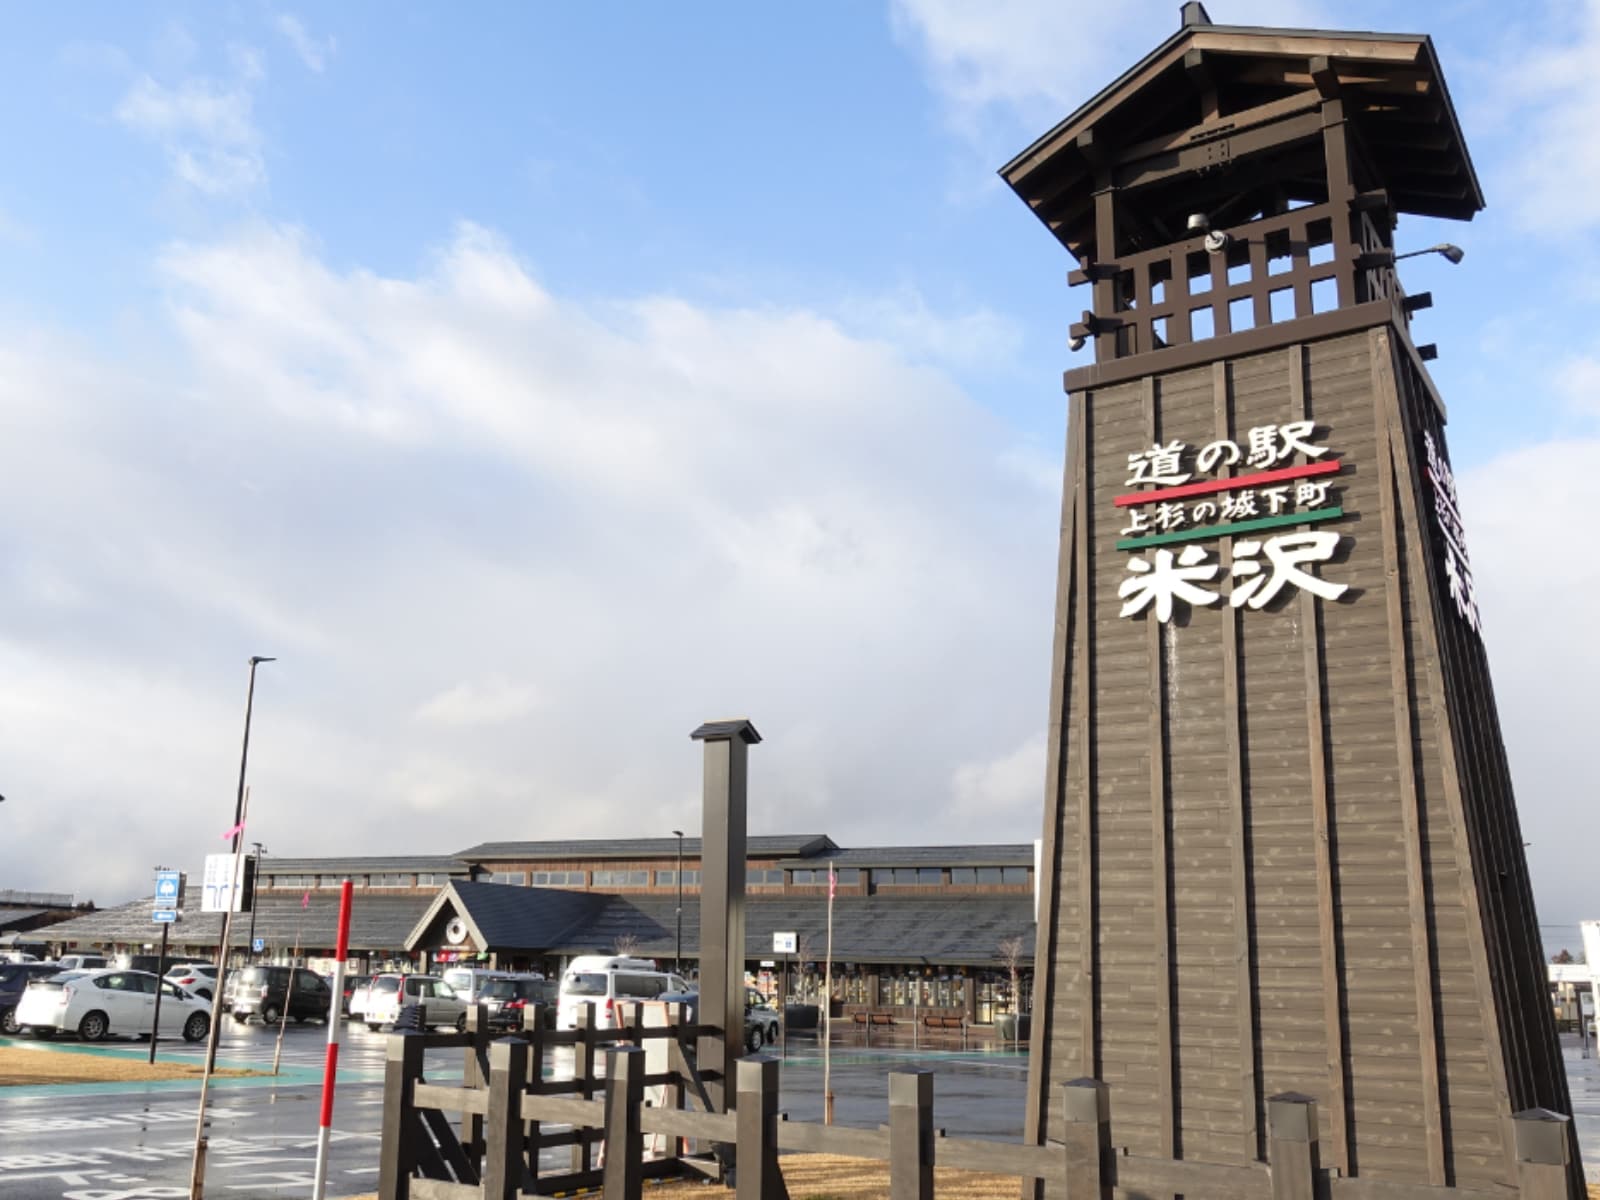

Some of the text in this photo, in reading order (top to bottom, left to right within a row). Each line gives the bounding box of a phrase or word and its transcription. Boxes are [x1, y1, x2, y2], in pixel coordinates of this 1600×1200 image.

[1124, 420, 1331, 487] 道の駅
[1119, 480, 1334, 537] 上杉の城下町
[1118, 530, 1349, 623] 米沢
